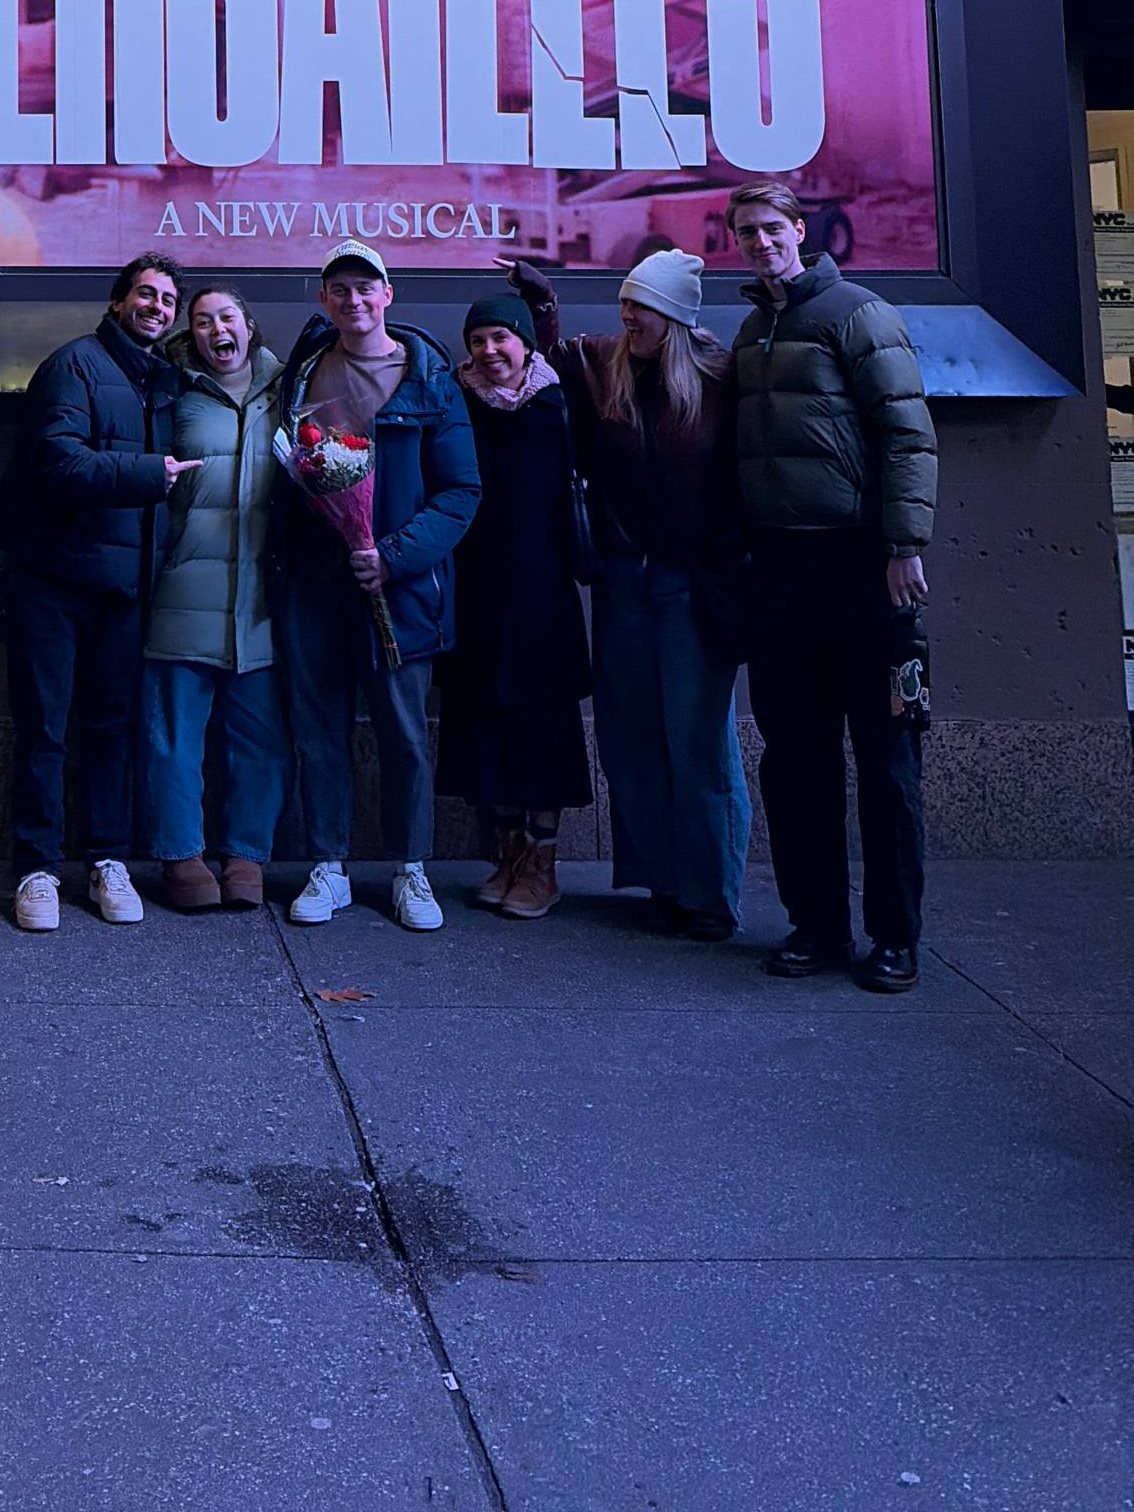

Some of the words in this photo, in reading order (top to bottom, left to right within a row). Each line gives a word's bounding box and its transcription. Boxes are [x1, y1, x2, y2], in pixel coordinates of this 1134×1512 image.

[154, 201, 187, 237] A
[194, 201, 302, 238] NEW
[309, 201, 517, 239] MUSICAL
[1093, 212, 1126, 226] NYC
[1097, 287, 1132, 301] NYC
[1109, 440, 1134, 456] NY
